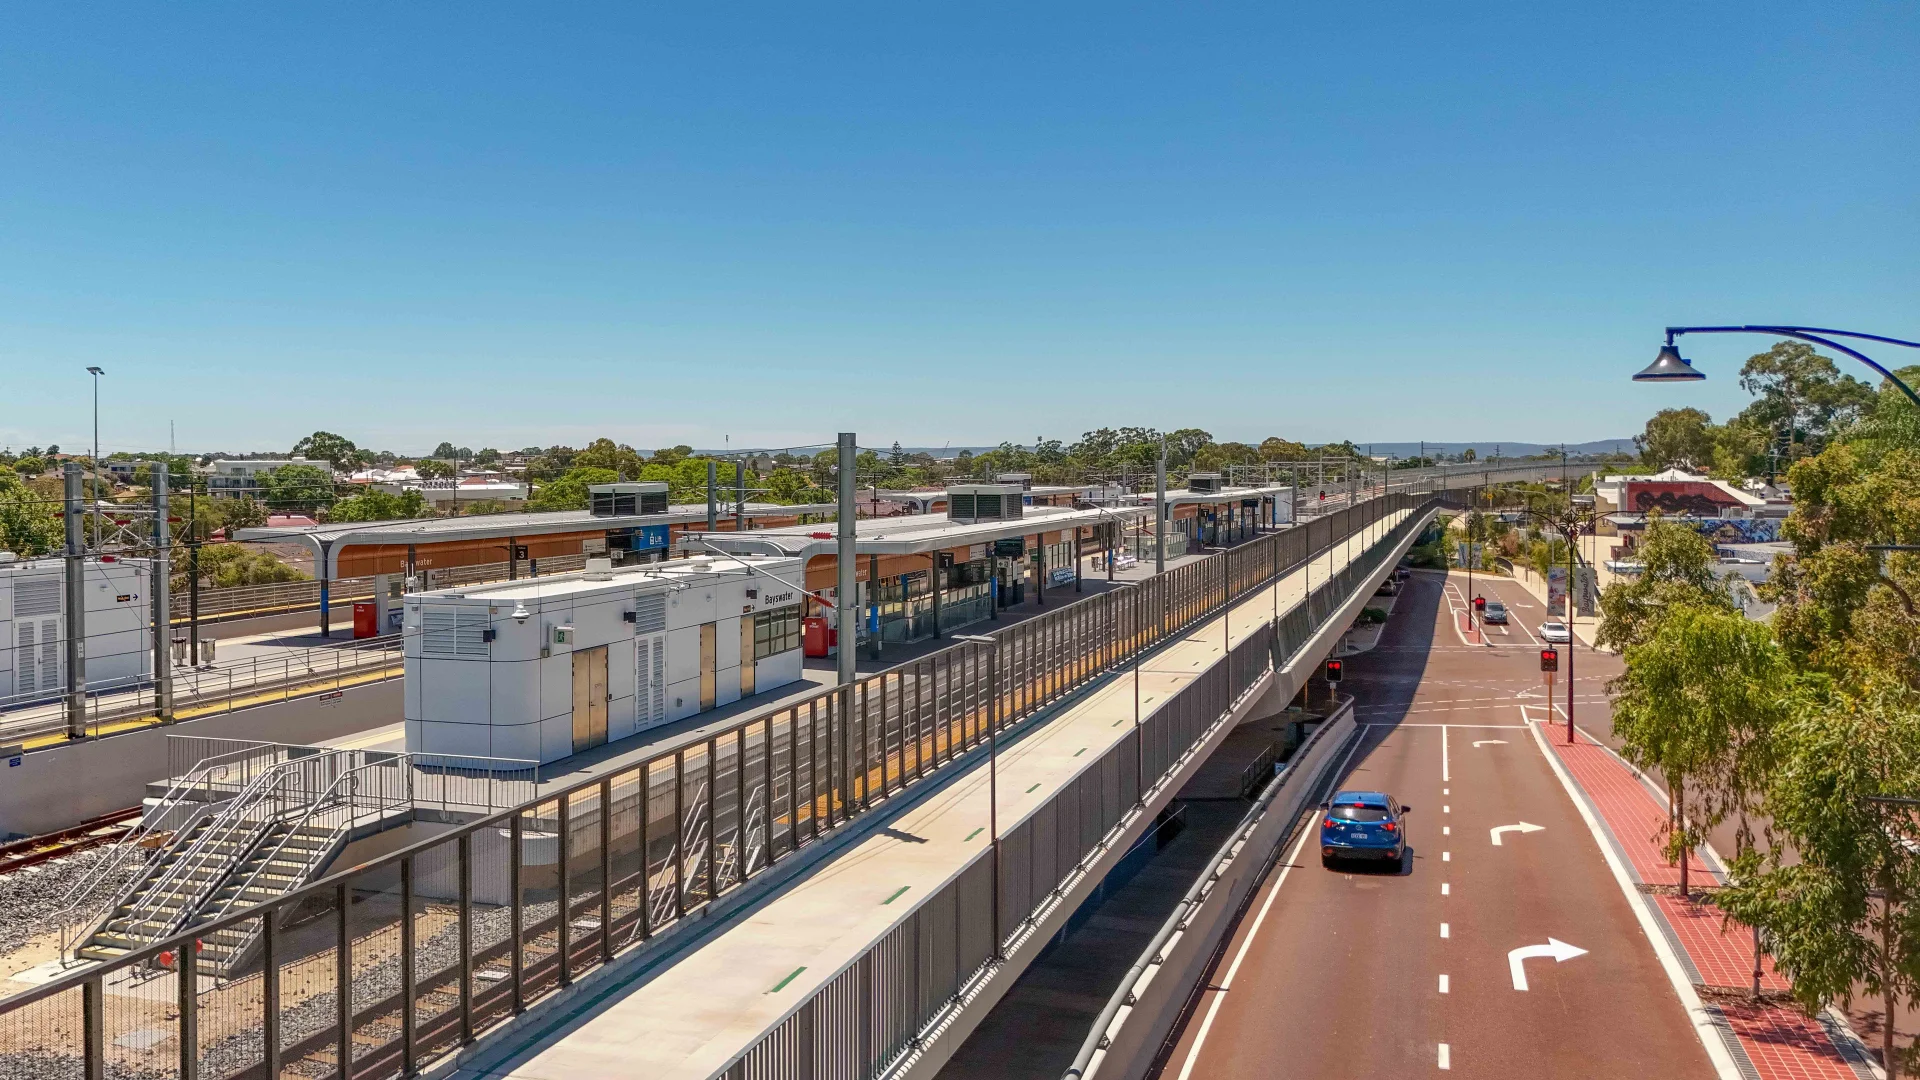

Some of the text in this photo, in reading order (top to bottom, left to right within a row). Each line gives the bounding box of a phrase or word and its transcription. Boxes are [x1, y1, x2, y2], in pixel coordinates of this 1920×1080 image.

[518, 551, 525, 559] 3
[400, 557, 433, 568] Bawater
[944, 558, 949, 567] 1
[1580, 571, 1593, 613] Bayswater
[765, 591, 793, 605] Bayswater
